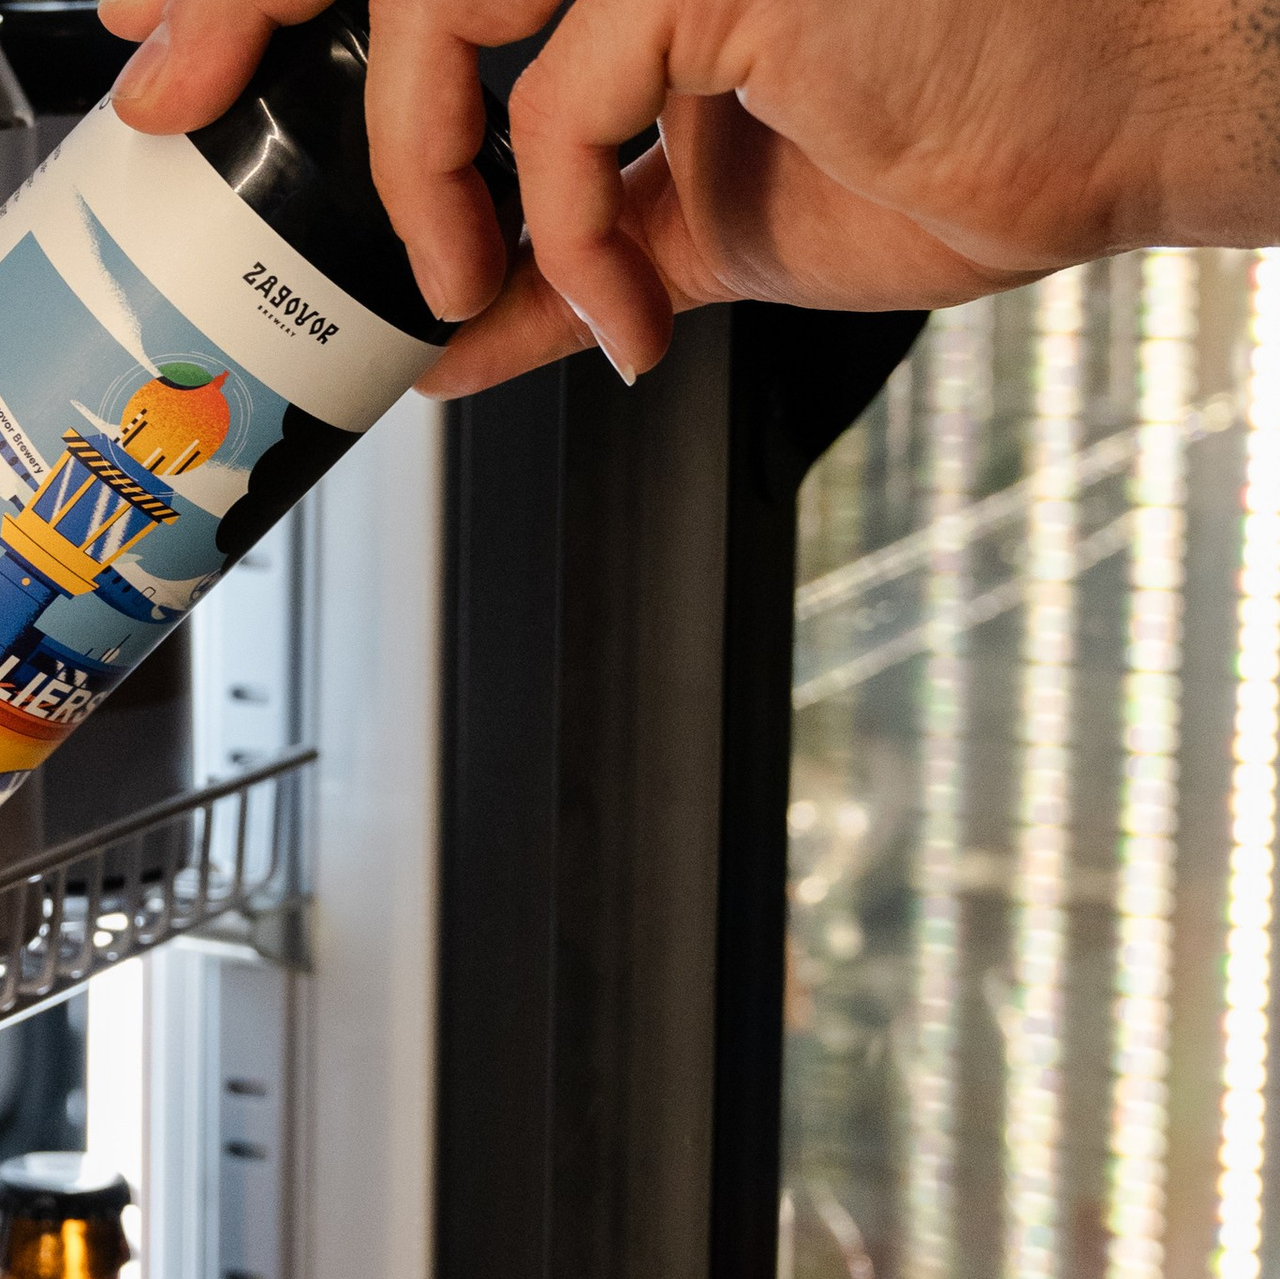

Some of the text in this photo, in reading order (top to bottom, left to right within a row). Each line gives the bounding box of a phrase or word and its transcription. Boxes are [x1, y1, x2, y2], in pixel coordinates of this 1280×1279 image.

[242, 261, 340, 345] ZAGOVOR
[257, 305, 296, 338] BREWERY
[13, 433, 44, 474] Brewery
